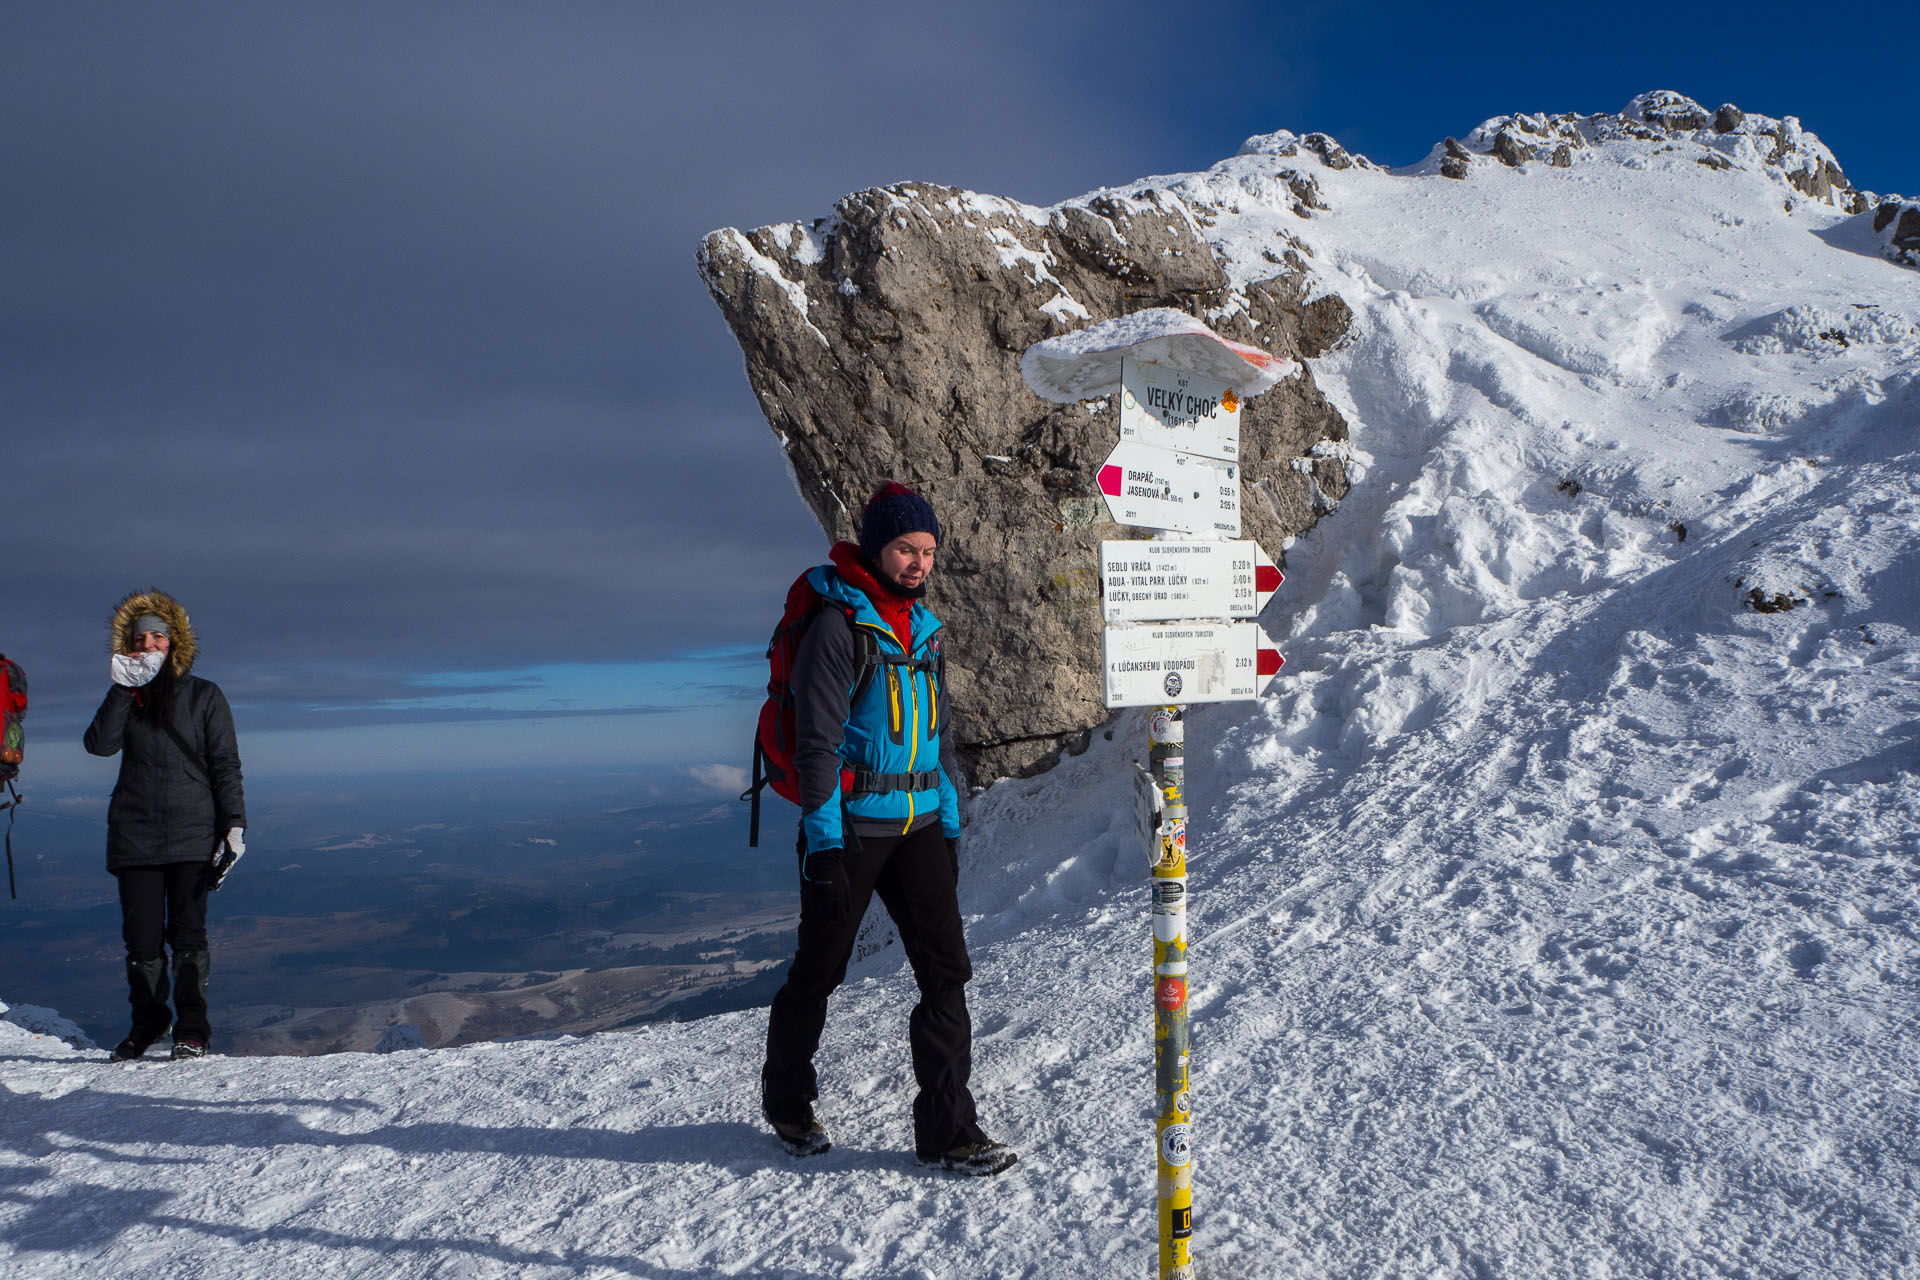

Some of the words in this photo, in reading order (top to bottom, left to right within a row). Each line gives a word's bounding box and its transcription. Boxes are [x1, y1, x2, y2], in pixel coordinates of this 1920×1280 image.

[1147, 386, 1184, 412] VEĽKÝ
[1187, 395, 1217, 419] CHOČ
[1167, 414, 1185, 427] (1611
[1124, 427, 1134, 436] 2011
[1128, 470, 1154, 484] DRAPÁČ
[1127, 486, 1160, 499] JASENOVÁ
[1232, 502, 1236, 510] h
[1108, 562, 1128, 572] SEDLO
[1130, 560, 1152, 572] VRÁCA
[1247, 560, 1250, 569] h
[1108, 576, 1125, 586] AQUA
[1131, 576, 1148, 586] VITAL
[1150, 576, 1165, 586] PARK
[1168, 574, 1188, 586] LÚČKY
[1248, 574, 1251, 584] h
[1109, 589, 1131, 602] LÚČKY,
[1132, 591, 1152, 601] OBECNÝ
[1154, 590, 1167, 600] ÚRAD
[1248, 588, 1252, 598] h
[1111, 662, 1115, 672] K
[1118, 660, 1160, 672] LÚČANSKÉMU
[1164, 659, 1195, 671] VODOPÁDU
[1236, 658, 1247, 667] 2:12
[1248, 658, 1252, 667] h
